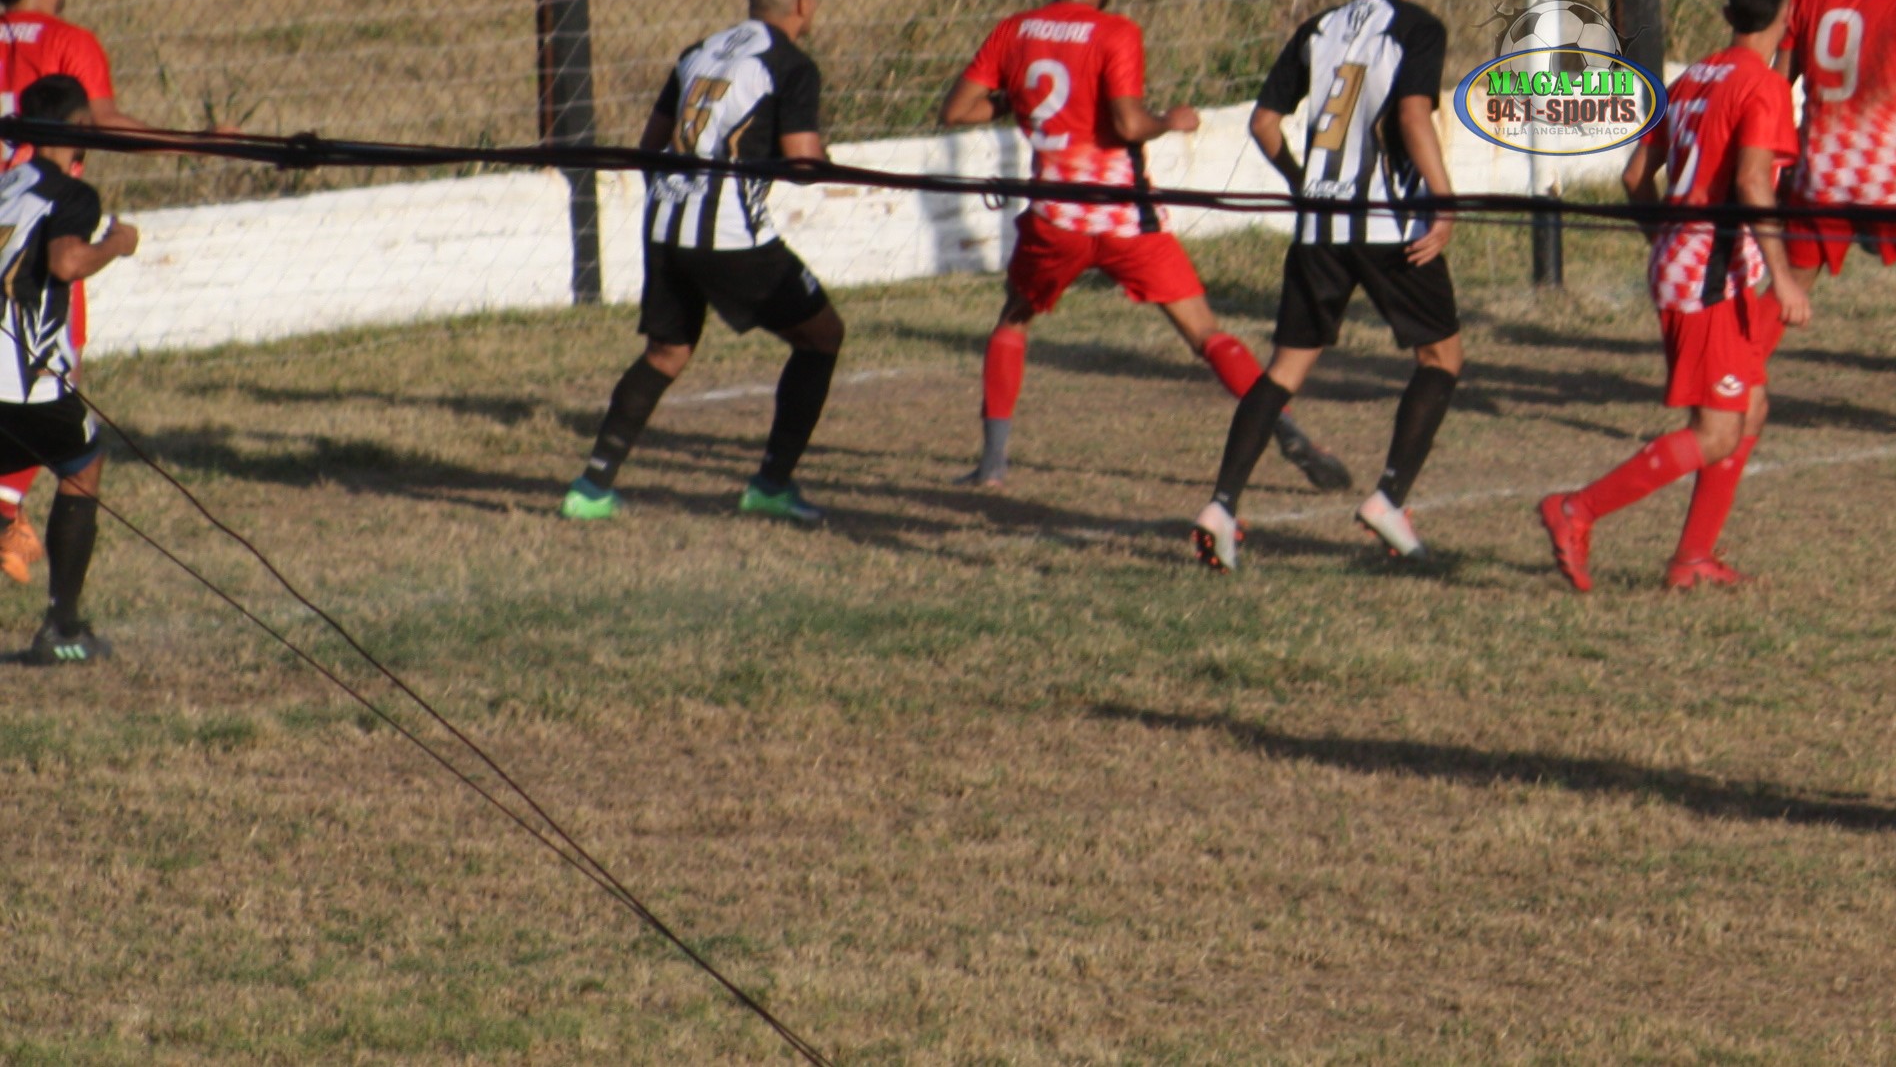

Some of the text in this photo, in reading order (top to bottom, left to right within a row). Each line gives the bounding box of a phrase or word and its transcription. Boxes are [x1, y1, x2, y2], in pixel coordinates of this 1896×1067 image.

[1814, 7, 1864, 102] 9
[1023, 57, 1071, 151] 2
[1312, 61, 1368, 150] 3
